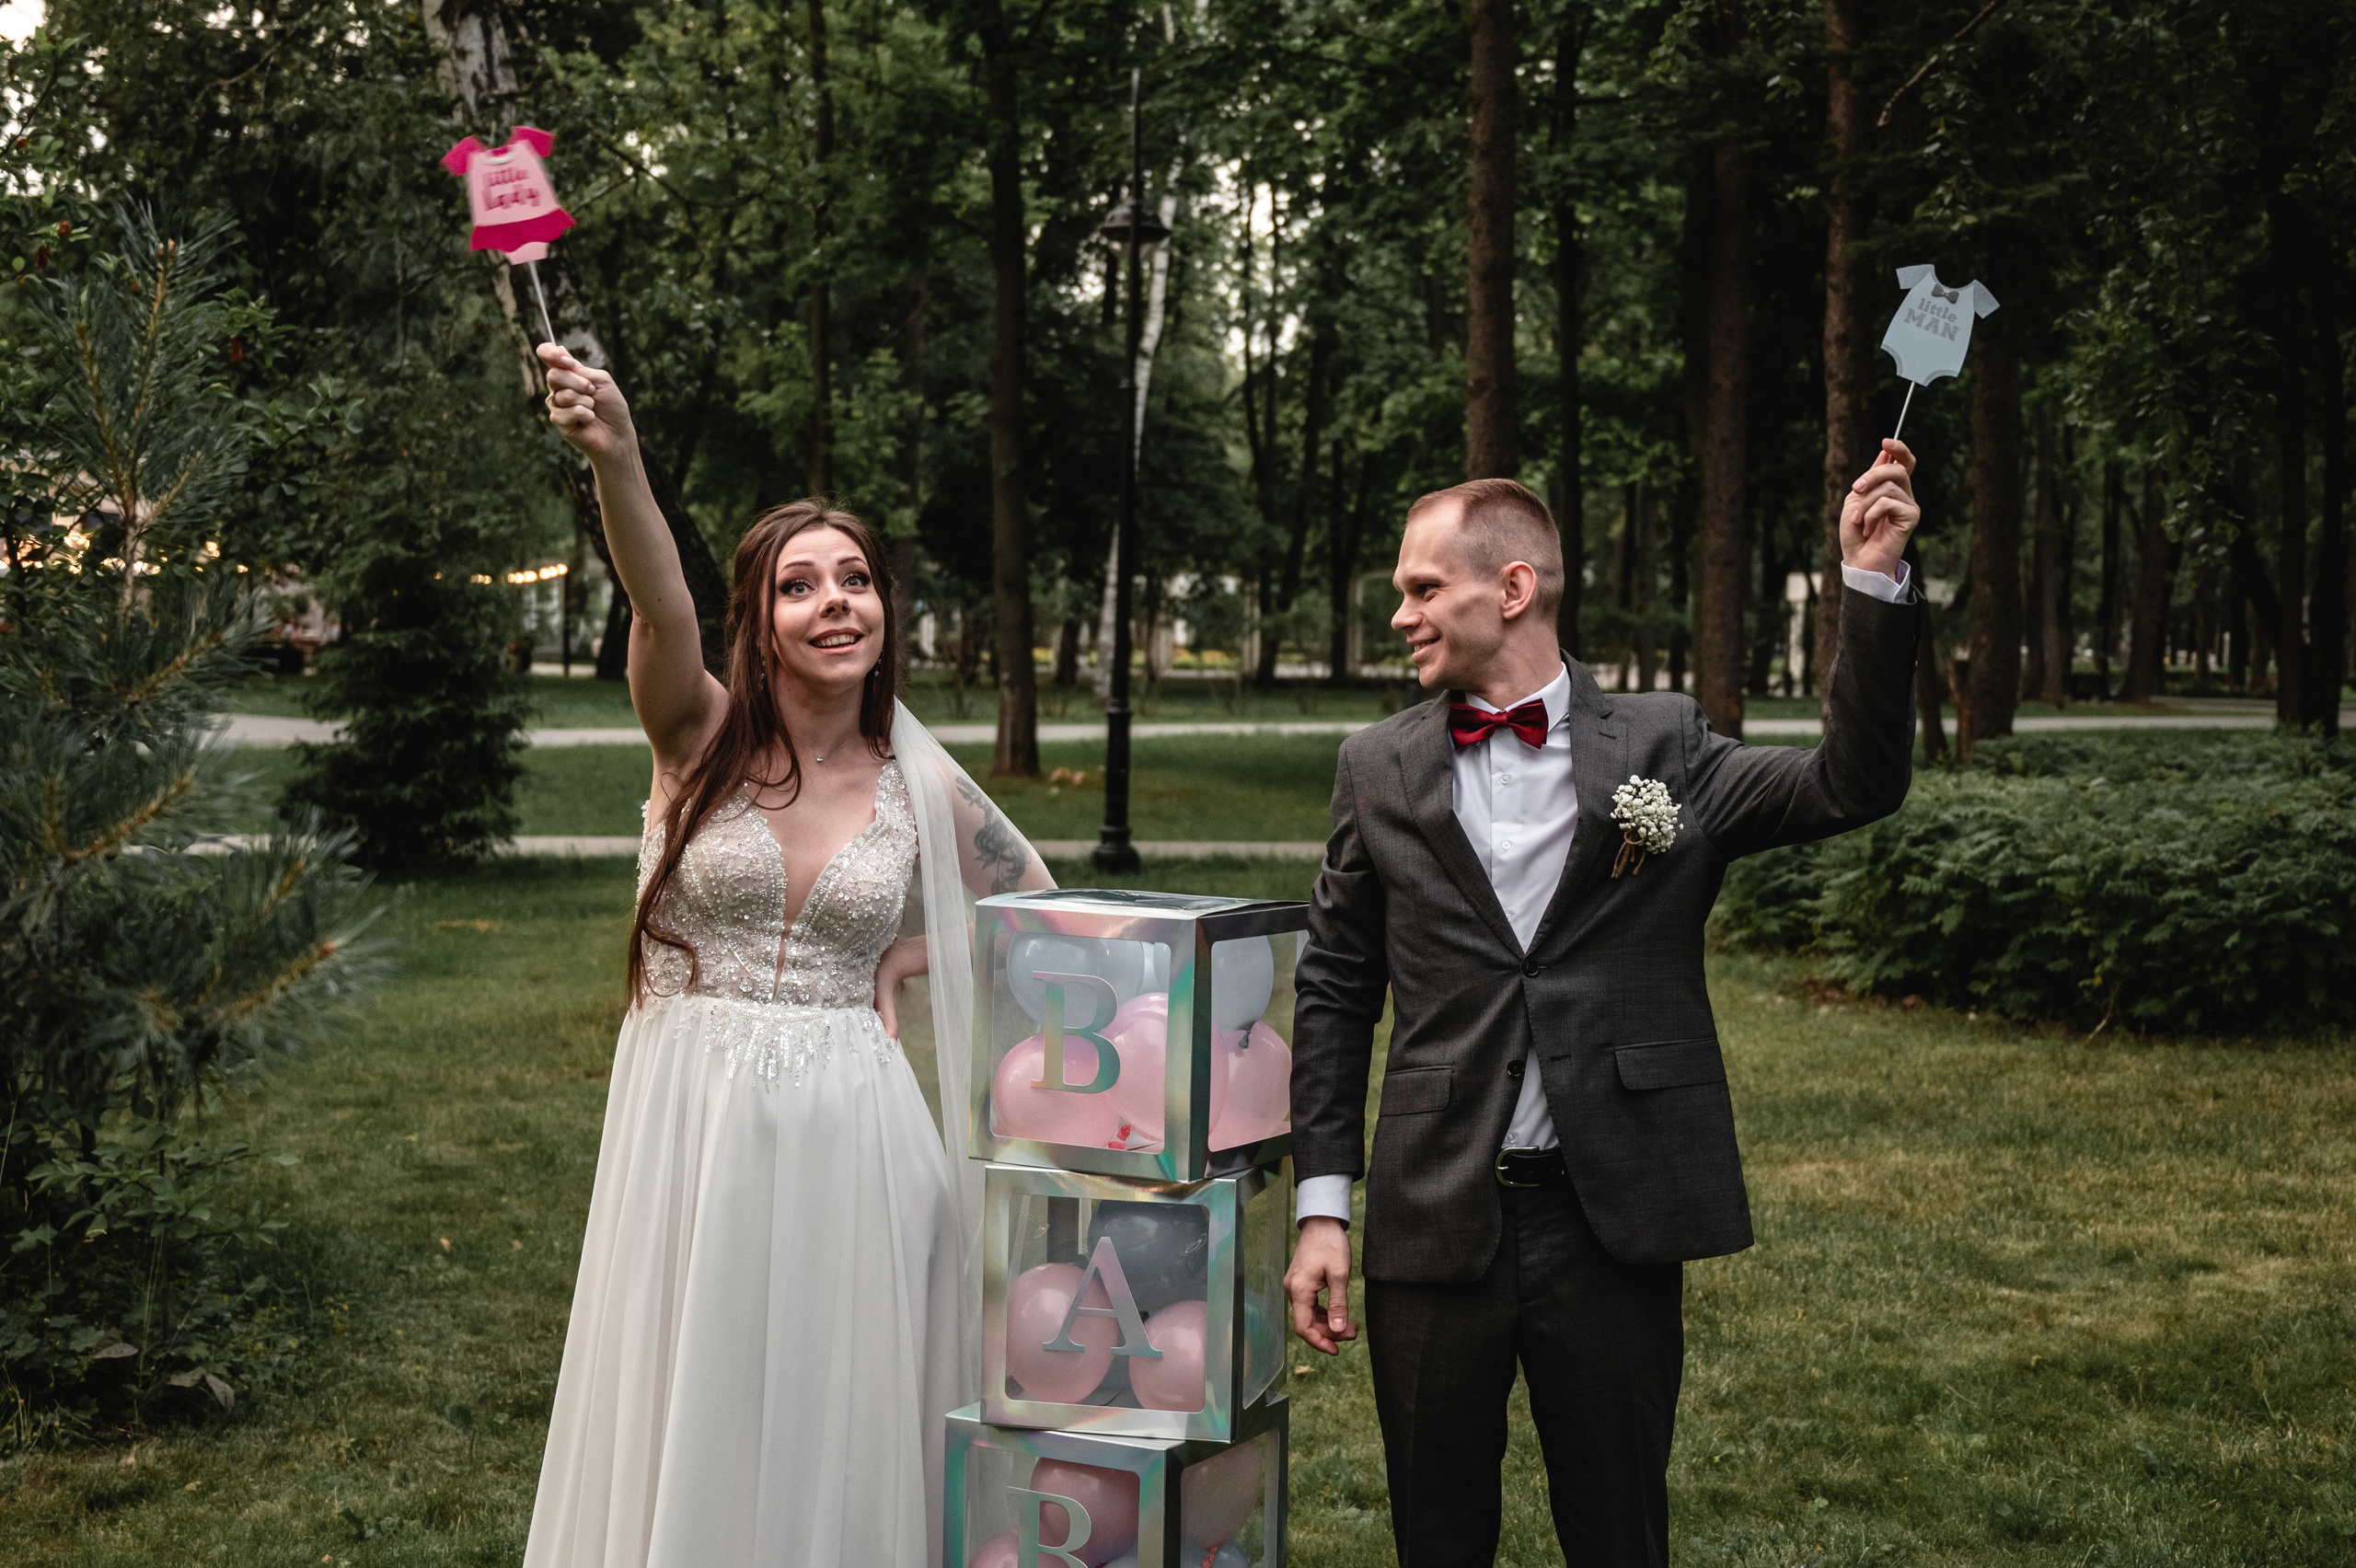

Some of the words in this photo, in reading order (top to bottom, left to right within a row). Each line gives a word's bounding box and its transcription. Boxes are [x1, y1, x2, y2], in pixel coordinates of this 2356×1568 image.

[1904, 308, 1960, 341] MAN
[1918, 298, 1957, 322] little
[1030, 970, 1121, 1094] B
[1042, 1236, 1163, 1358] A
